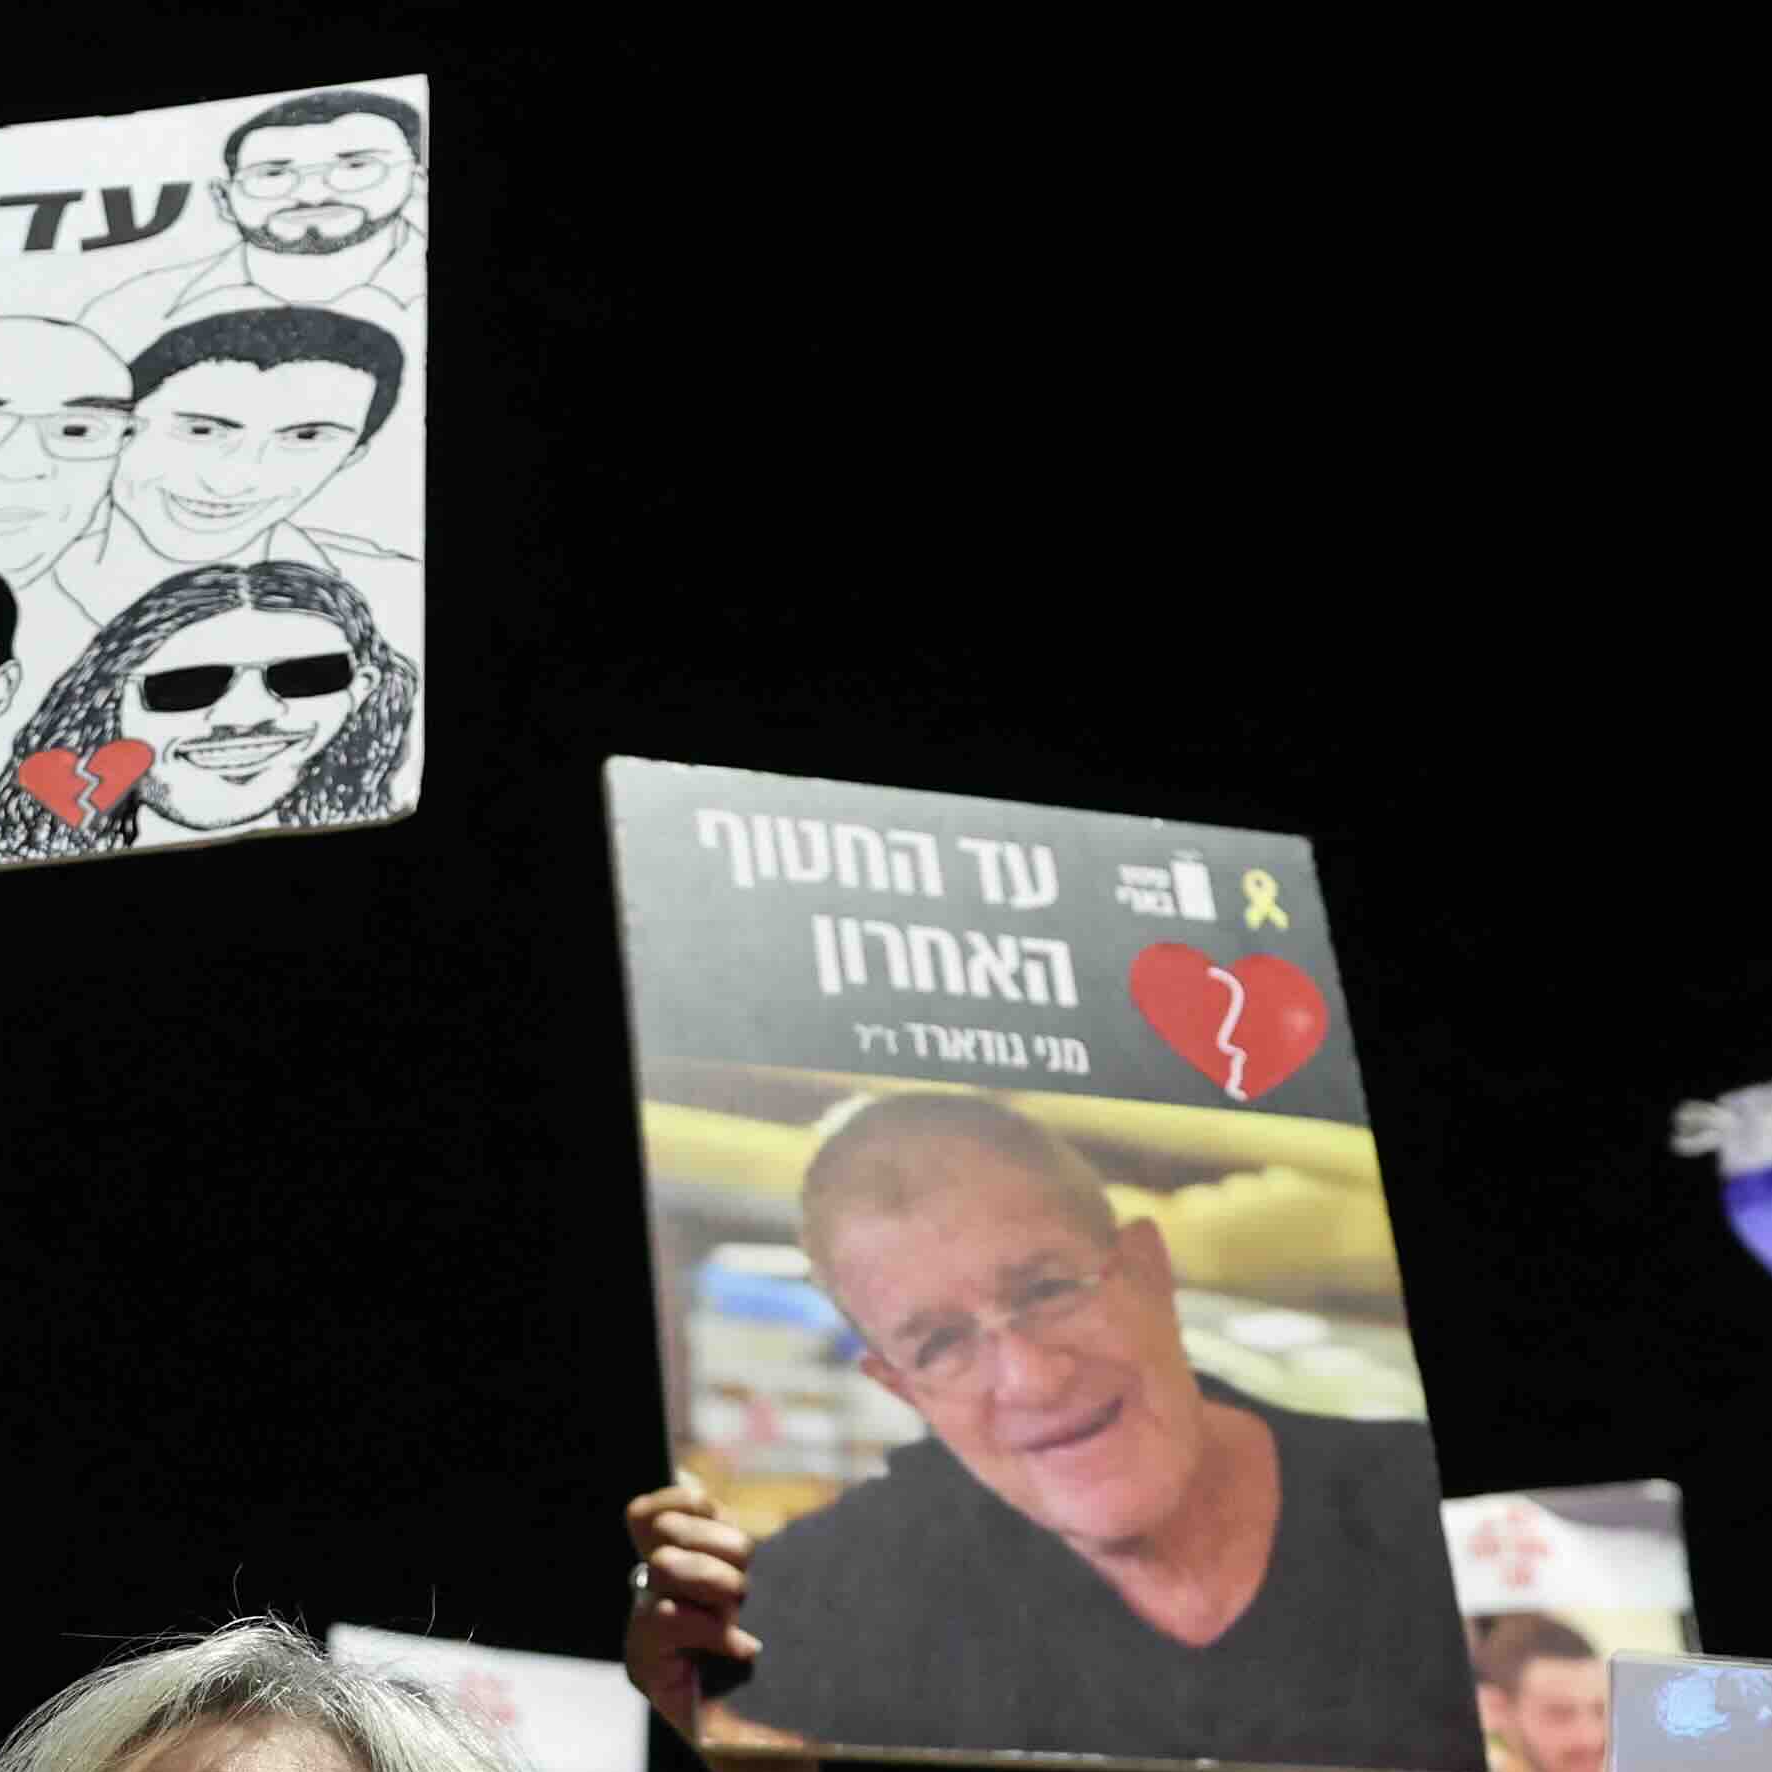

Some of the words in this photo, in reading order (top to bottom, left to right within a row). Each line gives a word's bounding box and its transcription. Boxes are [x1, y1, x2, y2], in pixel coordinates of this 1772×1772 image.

[696, 806, 946, 898] החטוף
[957, 834, 1059, 908] עד
[811, 912, 1080, 1010] האחרון
[901, 1020, 1030, 1070] גודארד
[1031, 1034, 1091, 1076] מני
